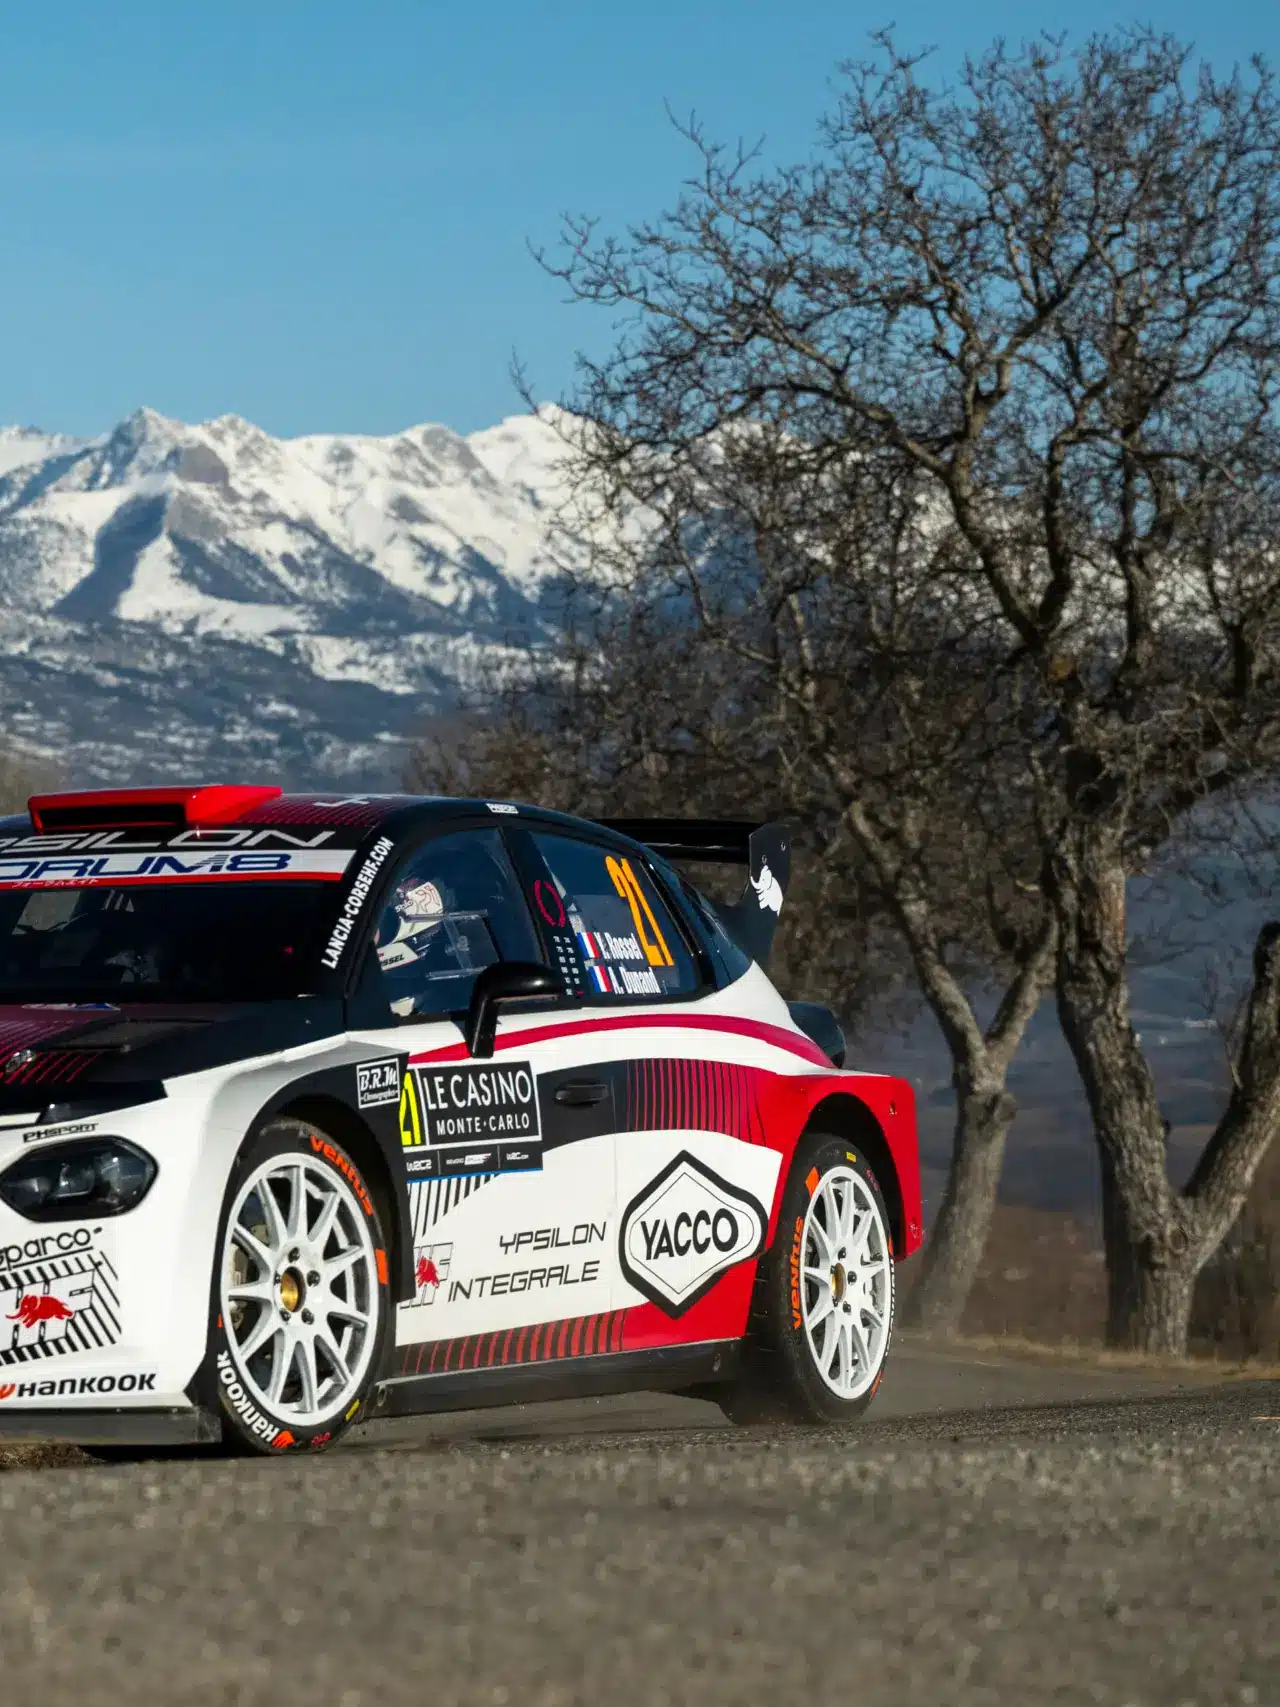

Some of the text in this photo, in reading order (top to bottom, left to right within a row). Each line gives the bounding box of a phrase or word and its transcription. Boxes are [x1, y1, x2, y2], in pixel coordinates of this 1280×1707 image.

[605, 855, 675, 966] 21
[604, 932, 644, 960] Rossel
[619, 966, 661, 995] Dunand
[423, 1070, 532, 1110] LE CASINO
[499, 1221, 607, 1254] YPSILON
[640, 1208, 739, 1261] YACCO
[447, 1260, 600, 1302] INTEGRALE
